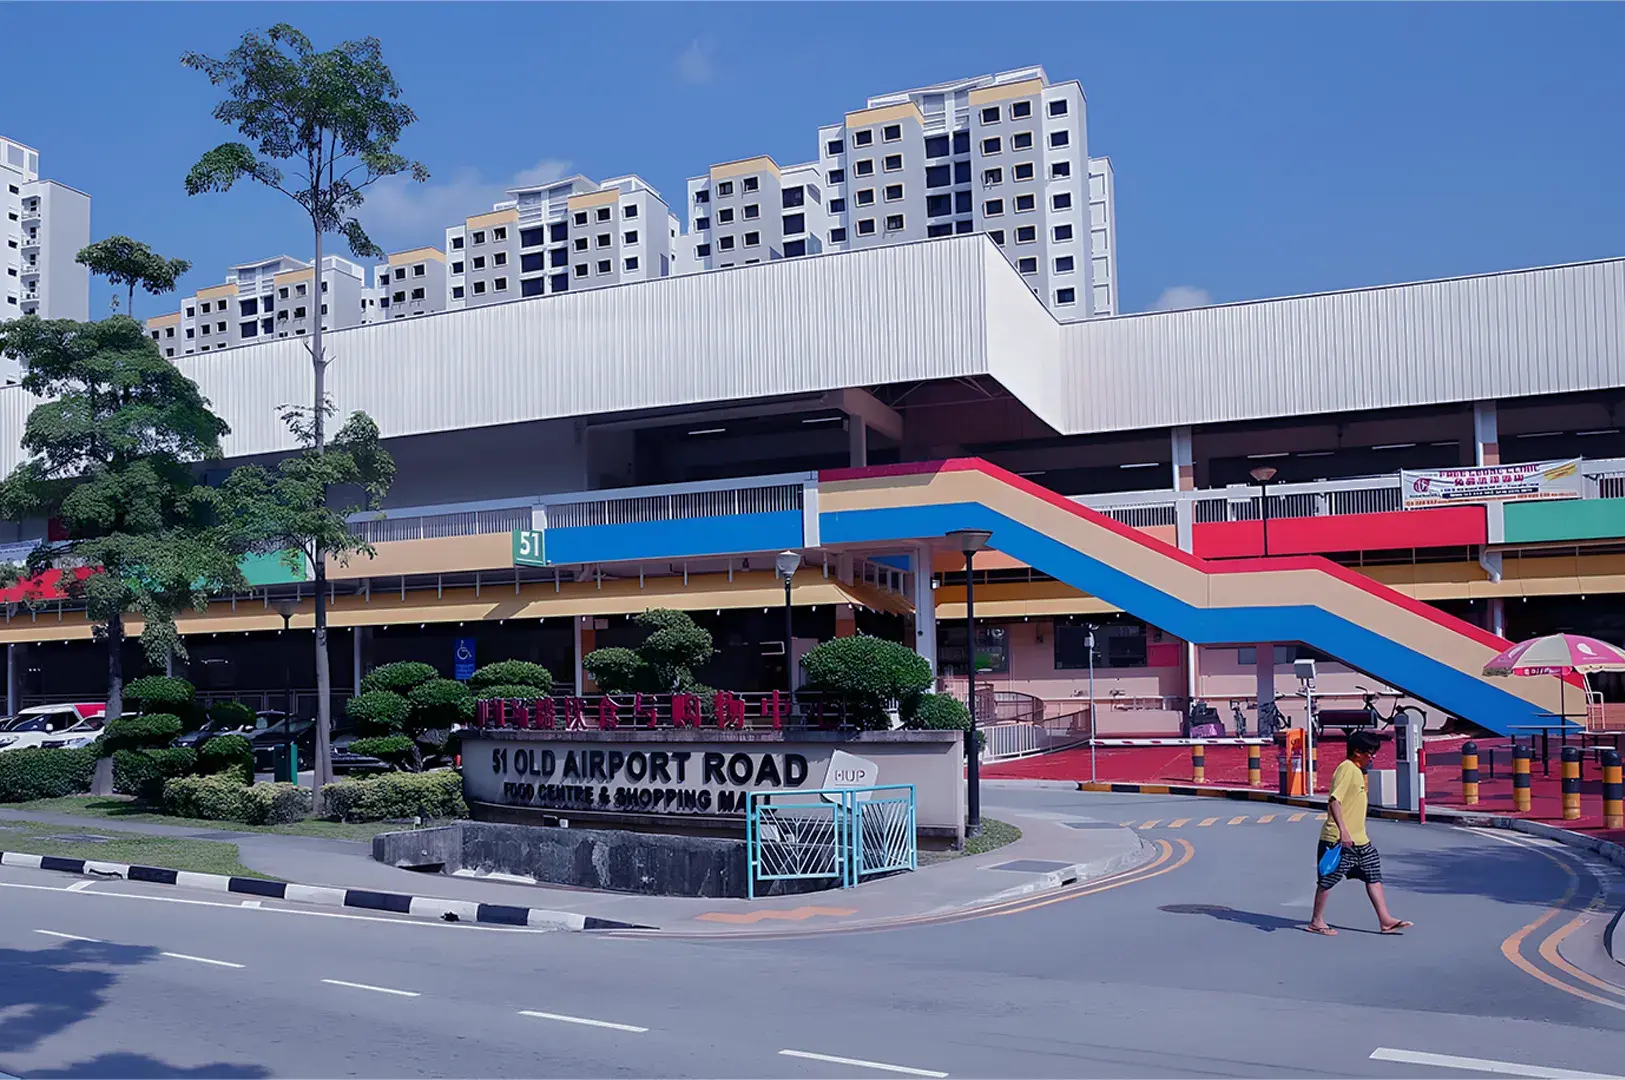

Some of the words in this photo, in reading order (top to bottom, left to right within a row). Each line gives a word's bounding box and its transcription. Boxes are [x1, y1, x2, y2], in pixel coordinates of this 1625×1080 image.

[520, 531, 539, 556] 51
[492, 748, 507, 774] 51
[514, 749, 556, 776] OLD
[562, 750, 692, 784] AIRPORT
[702, 752, 808, 787] ROAD
[503, 782, 534, 801] FOOD
[538, 784, 593, 804] CENTRE
[599, 786, 611, 806] &
[613, 787, 711, 811] SHOPPING
